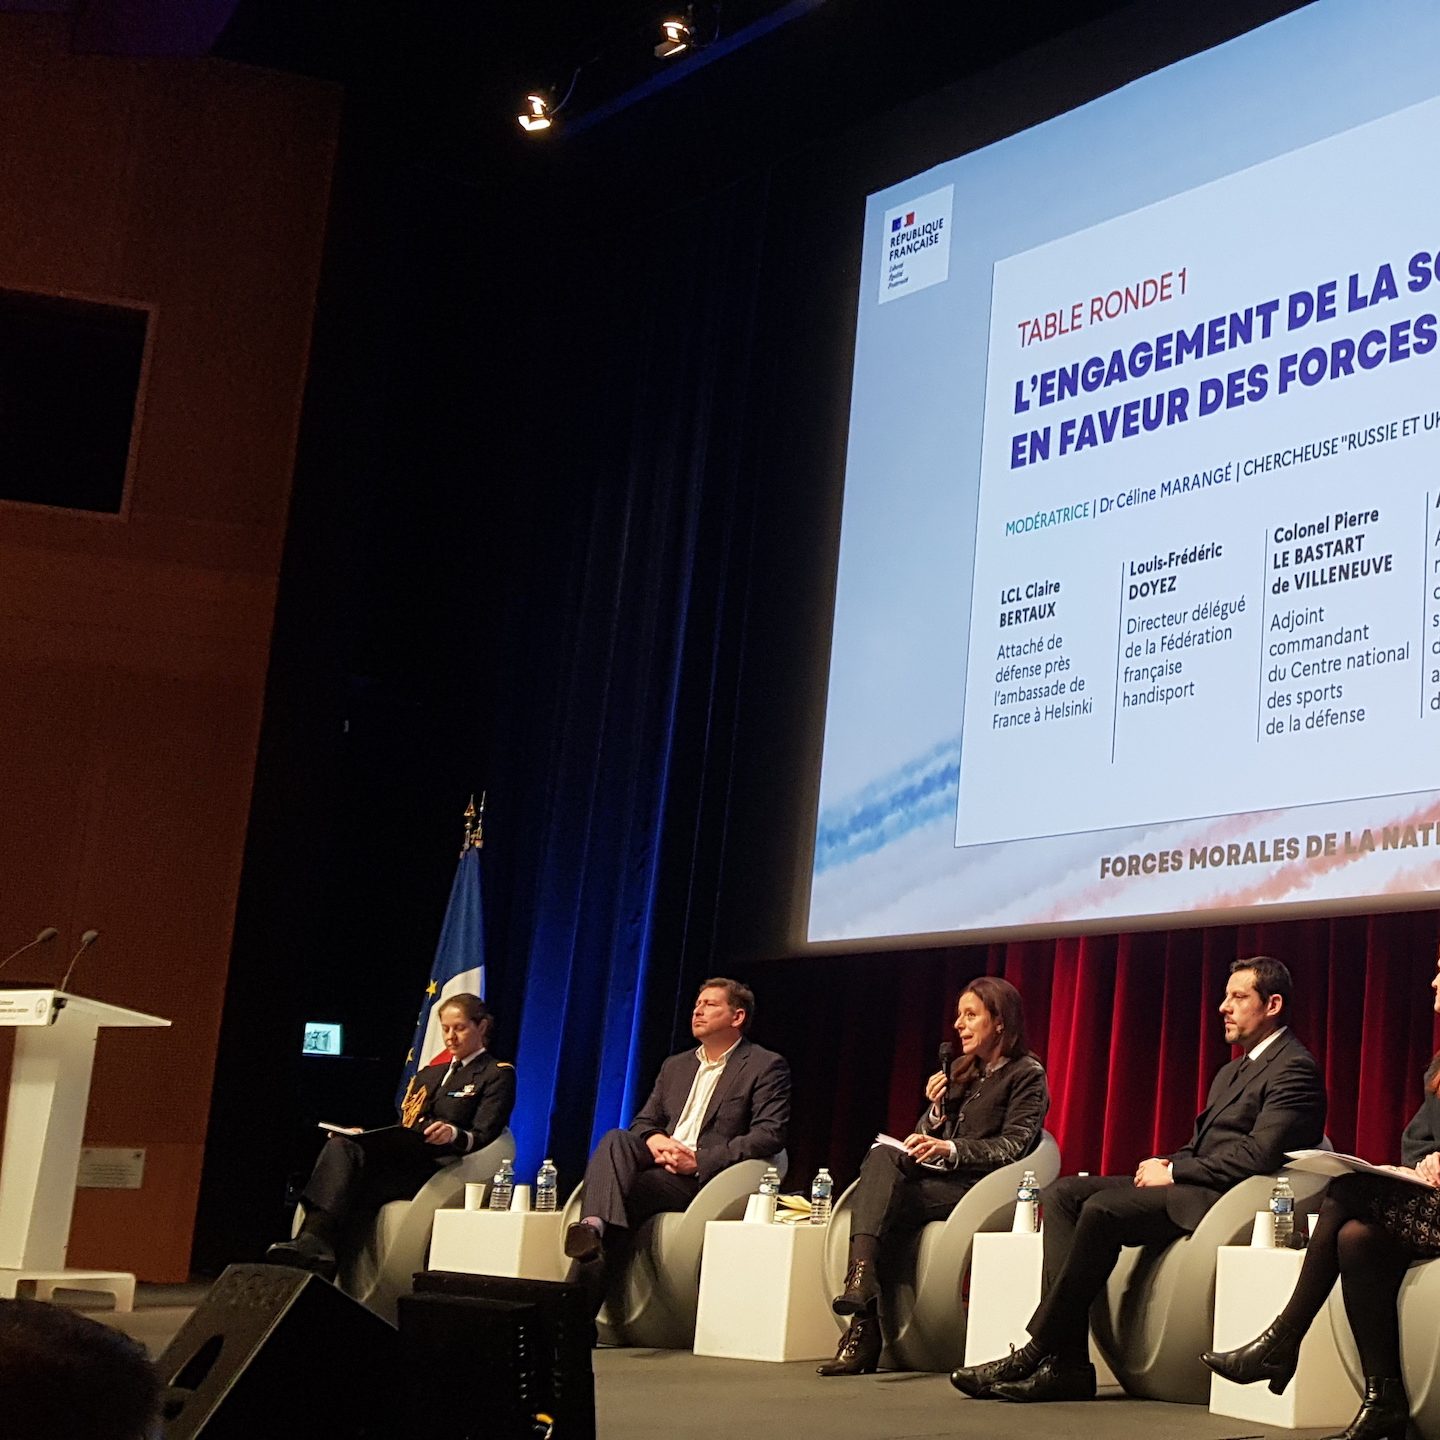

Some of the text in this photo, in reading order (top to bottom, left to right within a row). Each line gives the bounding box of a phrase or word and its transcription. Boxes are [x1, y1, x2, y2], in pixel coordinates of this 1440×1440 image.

[889, 233, 939, 261] FRANÇAISE
[890, 217, 944, 248] RÉPUBLIQUE
[1018, 267, 1186, 348] TABLE RONDE 1
[1288, 280, 1337, 331] DE
[1348, 263, 1399, 312] LA
[1010, 426, 1051, 470] EN
[1059, 388, 1189, 456] FAVEUR
[1199, 366, 1268, 417] DES
[1278, 314, 1437, 395] FORCES
[1006, 502, 1090, 536] MODÉRATRICE
[1100, 497, 1114, 513] Dr
[1116, 488, 1156, 508] Céline
[1160, 464, 1232, 498] MARANGÉ
[1243, 437, 1338, 476] CHERCHEUSE
[1402, 416, 1420, 436] ET
[1274, 510, 1379, 544] Colonel Pierre
[1130, 542, 1222, 576] Louis-Frédéric
[1274, 534, 1365, 570] LE BASTART
[1129, 575, 1176, 600] DOYEZ
[1272, 554, 1392, 594] de VILLENEUVE
[1001, 580, 1060, 605] LCL Claire
[1000, 601, 1056, 628] BERTAUX
[1127, 595, 1246, 635] Directeur délégué
[1270, 607, 1324, 633] Adjoint
[996, 634, 1062, 660] Attaché de
[1125, 626, 1232, 658] de la Fédération
[1269, 624, 1369, 656] commandant
[995, 656, 1070, 683] défense près
[1124, 659, 1182, 680] française
[1268, 641, 1409, 682] du Centre national
[1070, 676, 1085, 692] de
[1122, 682, 1195, 707] handisport
[1267, 684, 1342, 709] des sports
[992, 697, 1092, 729] France à Helsinki
[1266, 708, 1365, 735] de la défense
[1100, 850, 1183, 879] FORCES
[1189, 838, 1300, 870] MORALES
[1306, 834, 1338, 858] DE
[1344, 830, 1376, 854] LA
